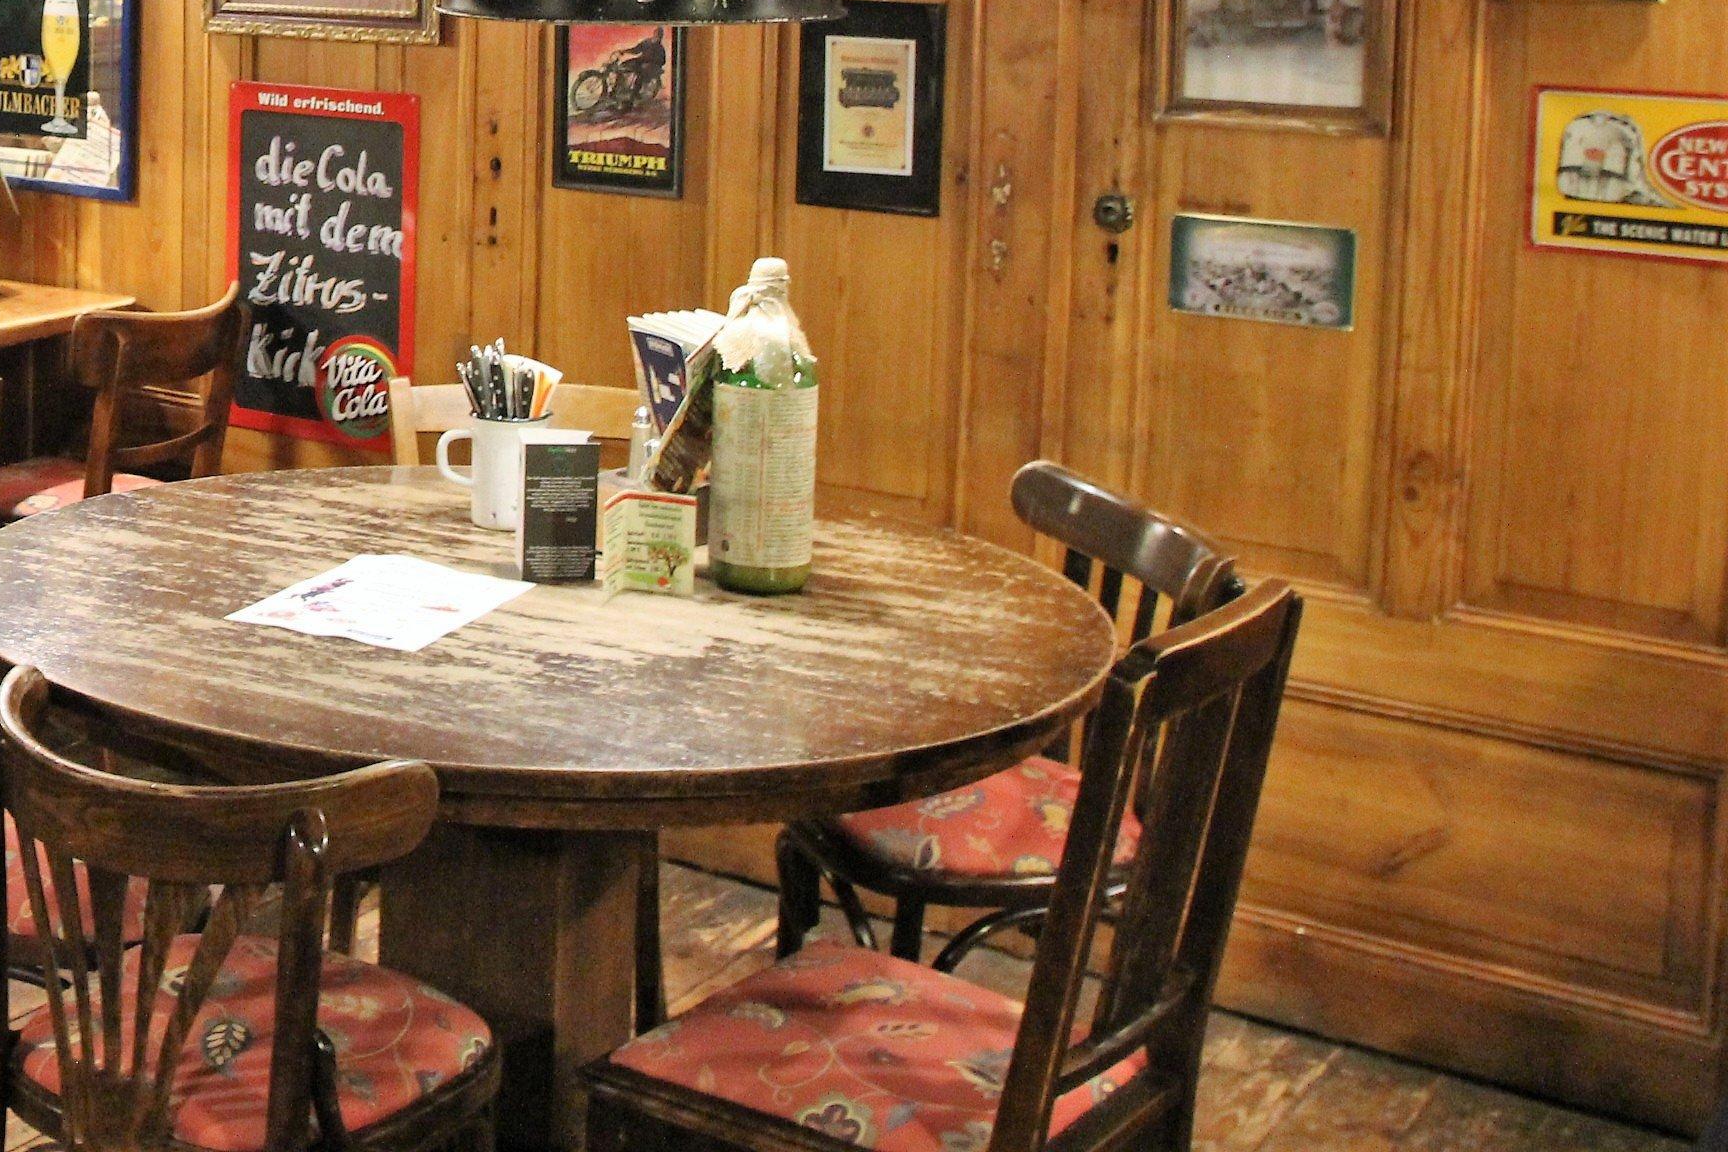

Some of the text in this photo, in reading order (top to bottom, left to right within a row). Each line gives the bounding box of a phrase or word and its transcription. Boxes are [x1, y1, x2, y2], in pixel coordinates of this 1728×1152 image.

[258, 92, 385, 116] Wild erfrischend.
[254, 135, 394, 199] die Cola
[568, 150, 667, 172] TRIUMPH
[254, 193, 405, 260] mit dem
[322, 354, 384, 391] Vita
[332, 384, 389, 422] Cola
